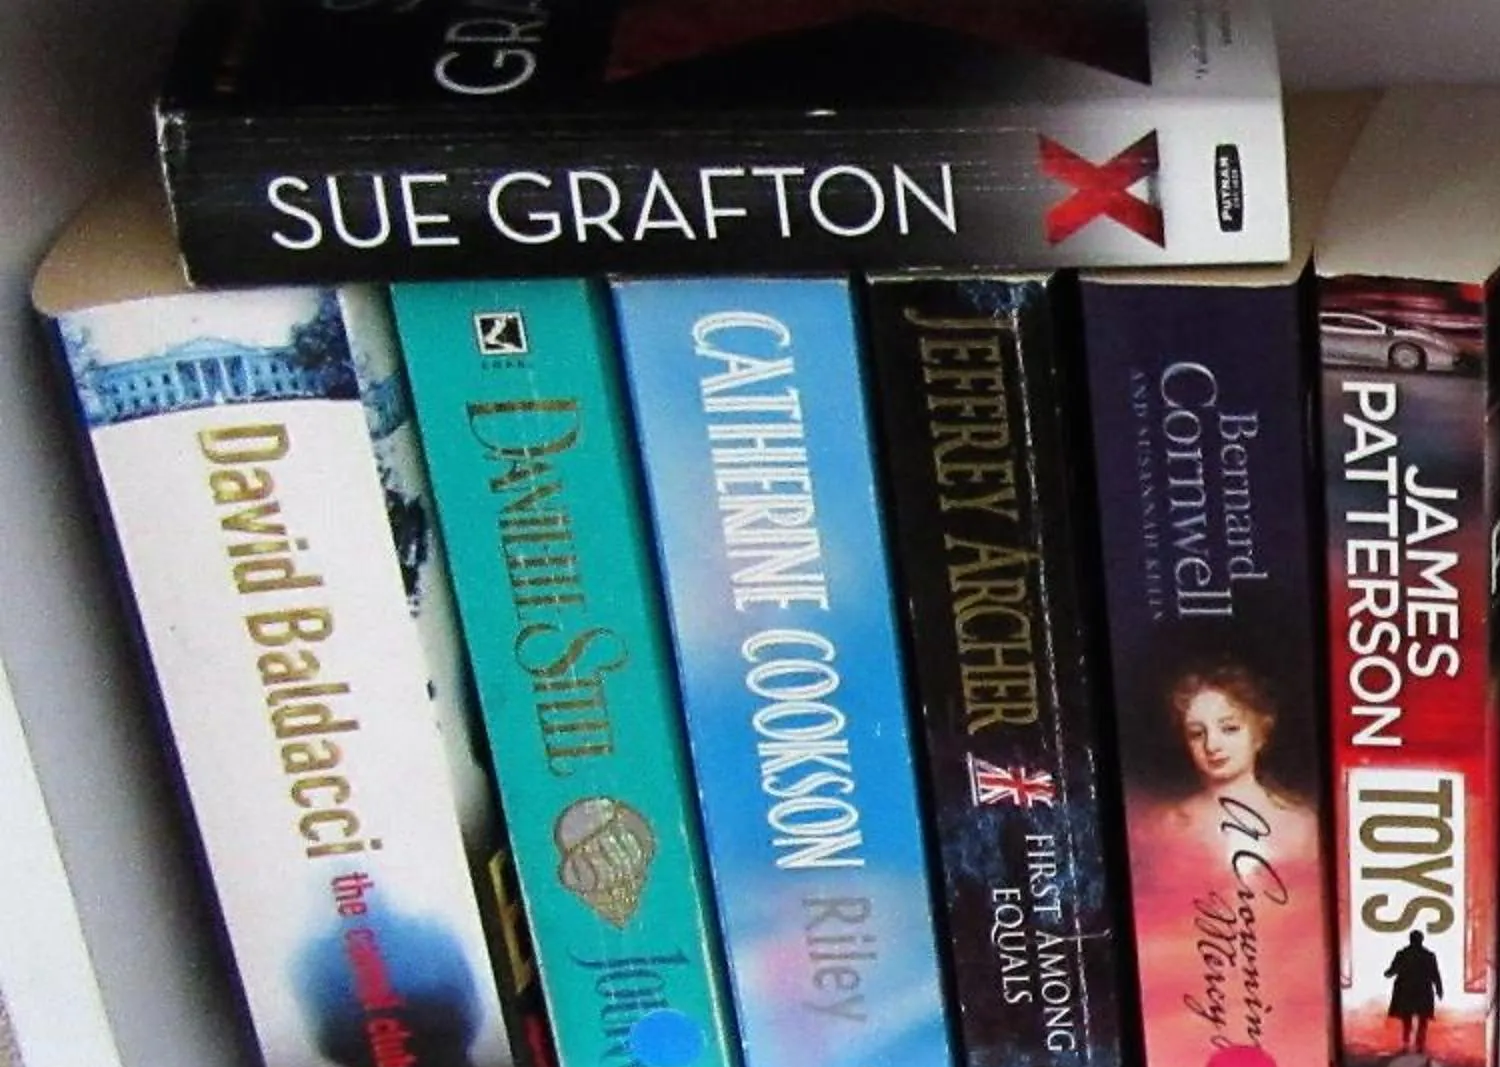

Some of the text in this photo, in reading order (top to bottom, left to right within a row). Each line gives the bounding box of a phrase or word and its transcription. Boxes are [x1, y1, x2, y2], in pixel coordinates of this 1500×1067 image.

[266, 163, 957, 250] SUE GRAFTON
[1039, 128, 1165, 249] X
[1219, 156, 1232, 222] PUTNAM
[904, 307, 1040, 735] JEFFREY ARCHER
[1161, 361, 1233, 619] Cornwell
[1219, 411, 1268, 582] Bernard
[1342, 381, 1403, 748] PATTERSON
[1404, 465, 1459, 680] JAMES
[198, 423, 383, 858] David Baldacci
[692, 311, 866, 869] CATHERINE COOKSON
[331, 871, 374, 918] the
[1358, 778, 1455, 935] TOYS
[802, 895, 877, 1024] Riley
[991, 887, 1032, 1004] EQUALS
[1025, 833, 1076, 1053] FIRST AMONG
[1184, 892, 1237, 1030] Mercy
[1230, 850, 1289, 1048] Crownin
